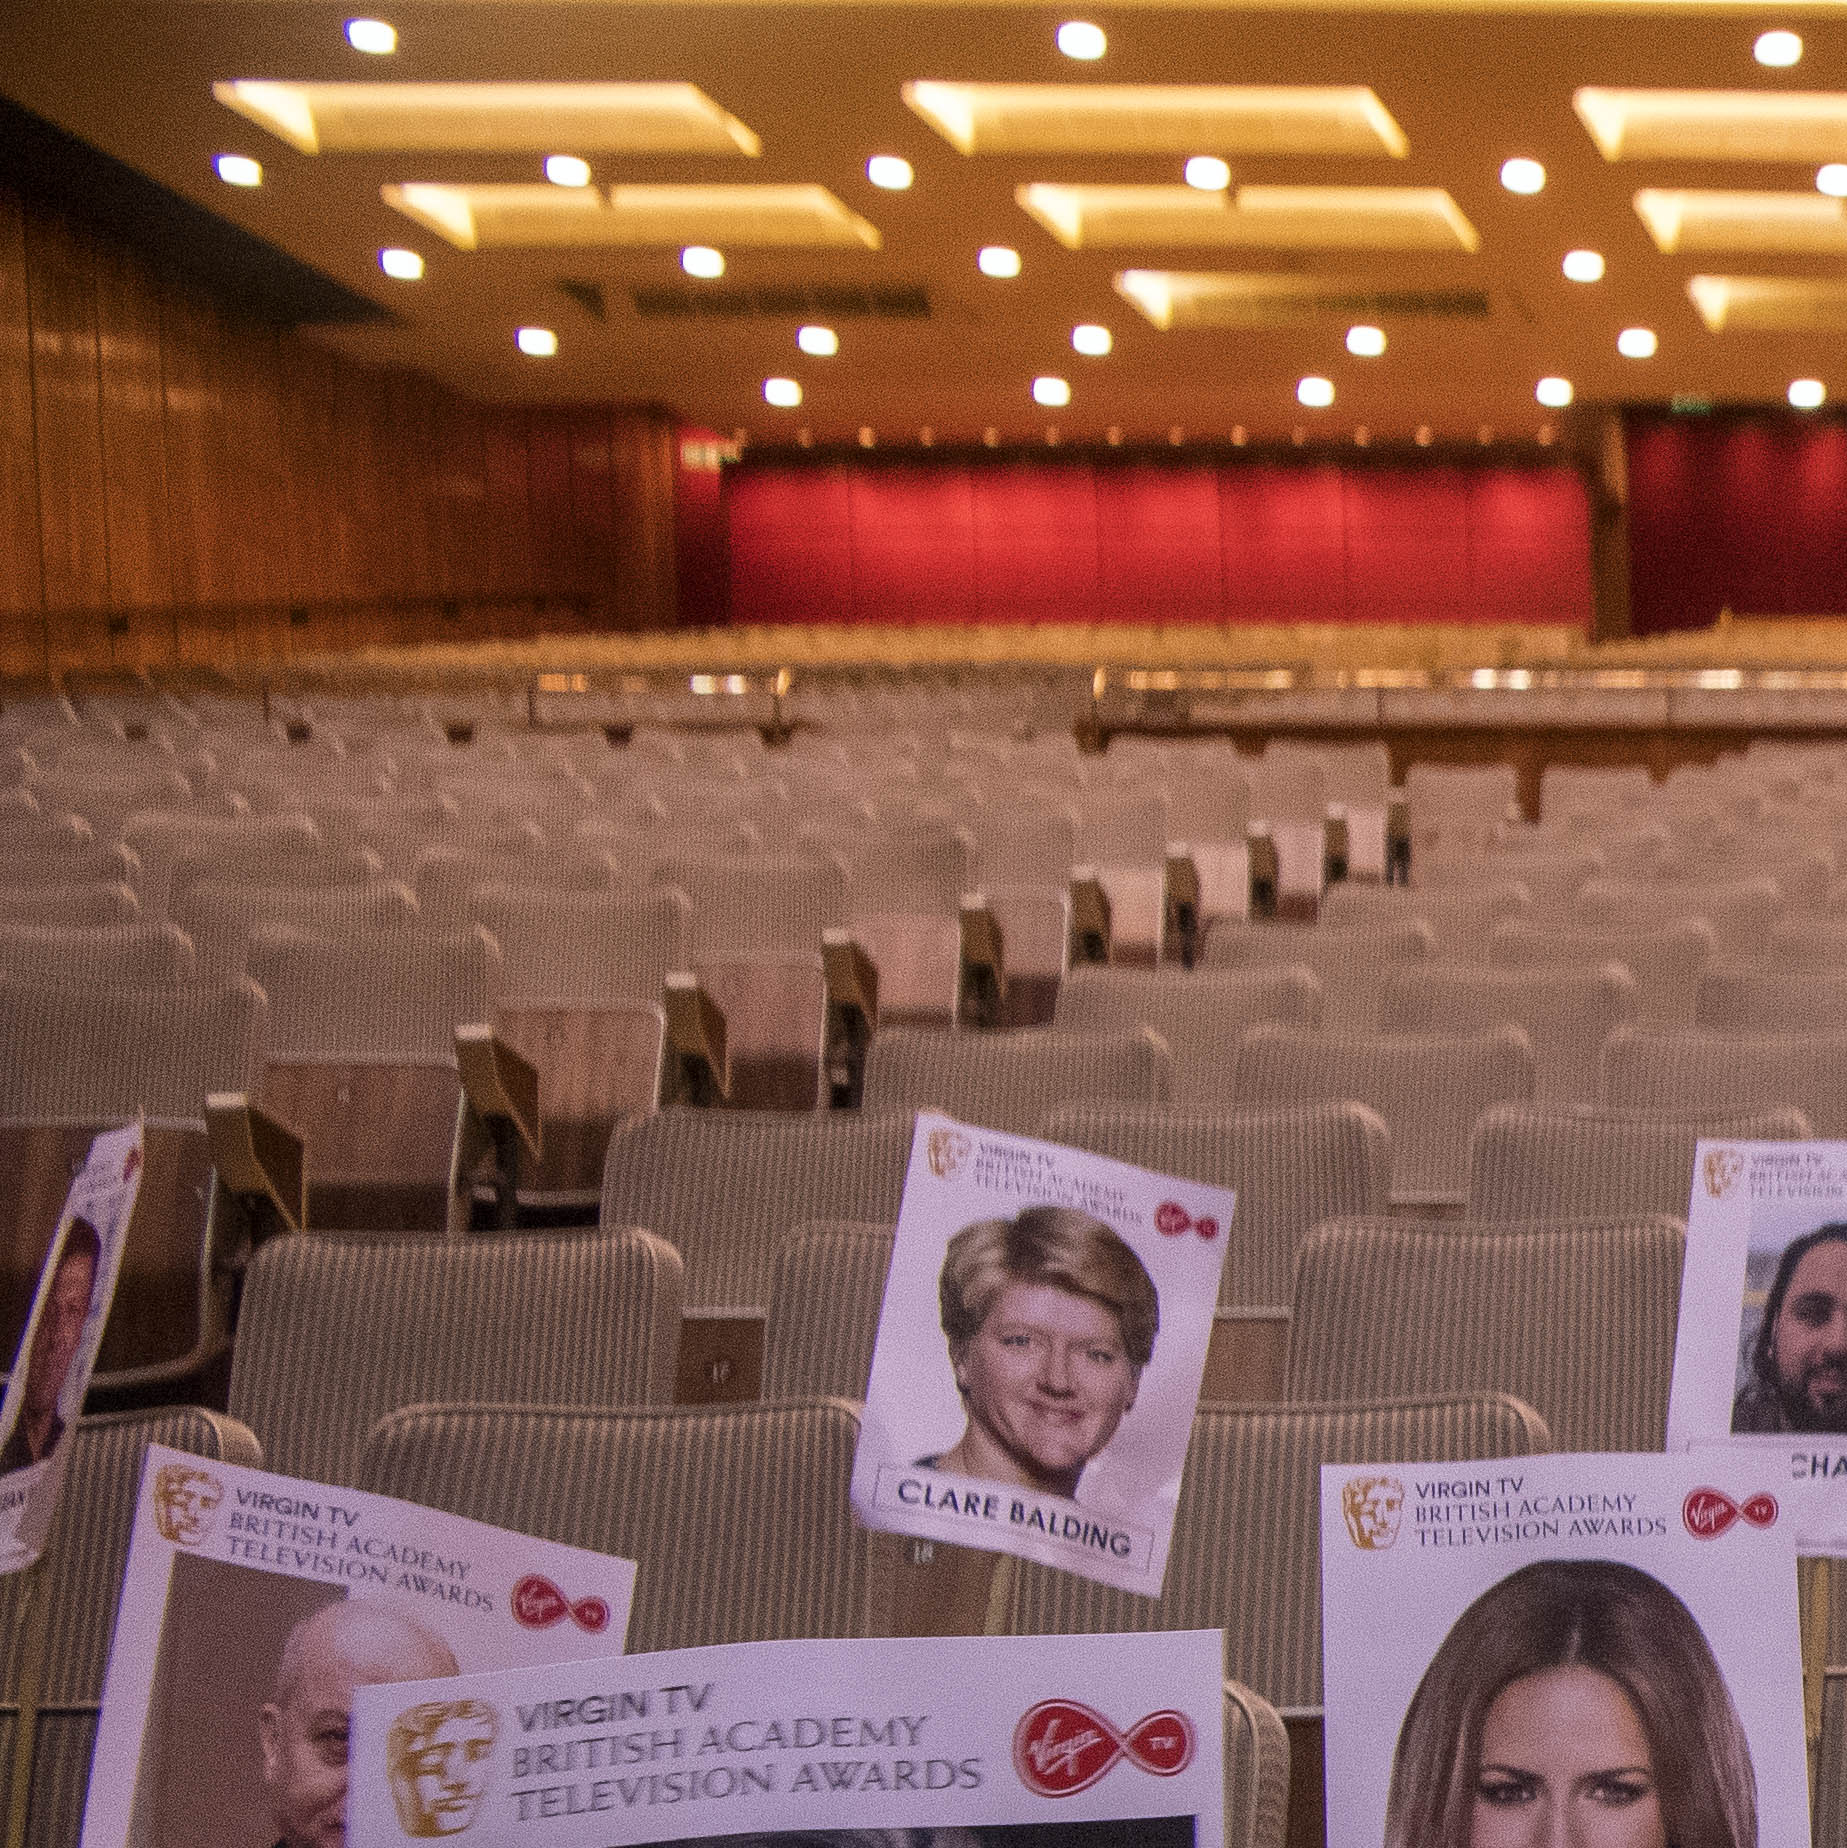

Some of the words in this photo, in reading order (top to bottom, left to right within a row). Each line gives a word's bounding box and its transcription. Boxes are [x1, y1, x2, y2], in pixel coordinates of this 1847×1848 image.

[237, 1487, 321, 1522] VIRGIN
[327, 1505, 360, 1528] TV
[898, 1478, 1000, 1521] CLARE
[1009, 1500, 1133, 1558] BALDING
[1415, 1479, 1490, 1500] VIRGIN
[1498, 1477, 1524, 1496] TV
[1415, 1501, 1511, 1524] BRITISH
[1519, 1494, 1637, 1519] ACADEMY
[229, 1511, 339, 1550] BRITISH
[348, 1536, 472, 1582] ACADEMY
[1415, 1521, 1559, 1547] TELEVISION
[1568, 1518, 1667, 1538] AWARDS
[228, 1535, 390, 1585] TELEVISION
[398, 1570, 495, 1615] AWARDS
[515, 1690, 649, 1735] VIRGIN
[660, 1683, 717, 1714] TV
[512, 1731, 687, 1781] BRITISH
[695, 1715, 929, 1756] ACADEMY
[1028, 1718, 1103, 1777] Virgin
[511, 1765, 773, 1824] TELEVISION
[788, 1757, 983, 1794] AWARDS
